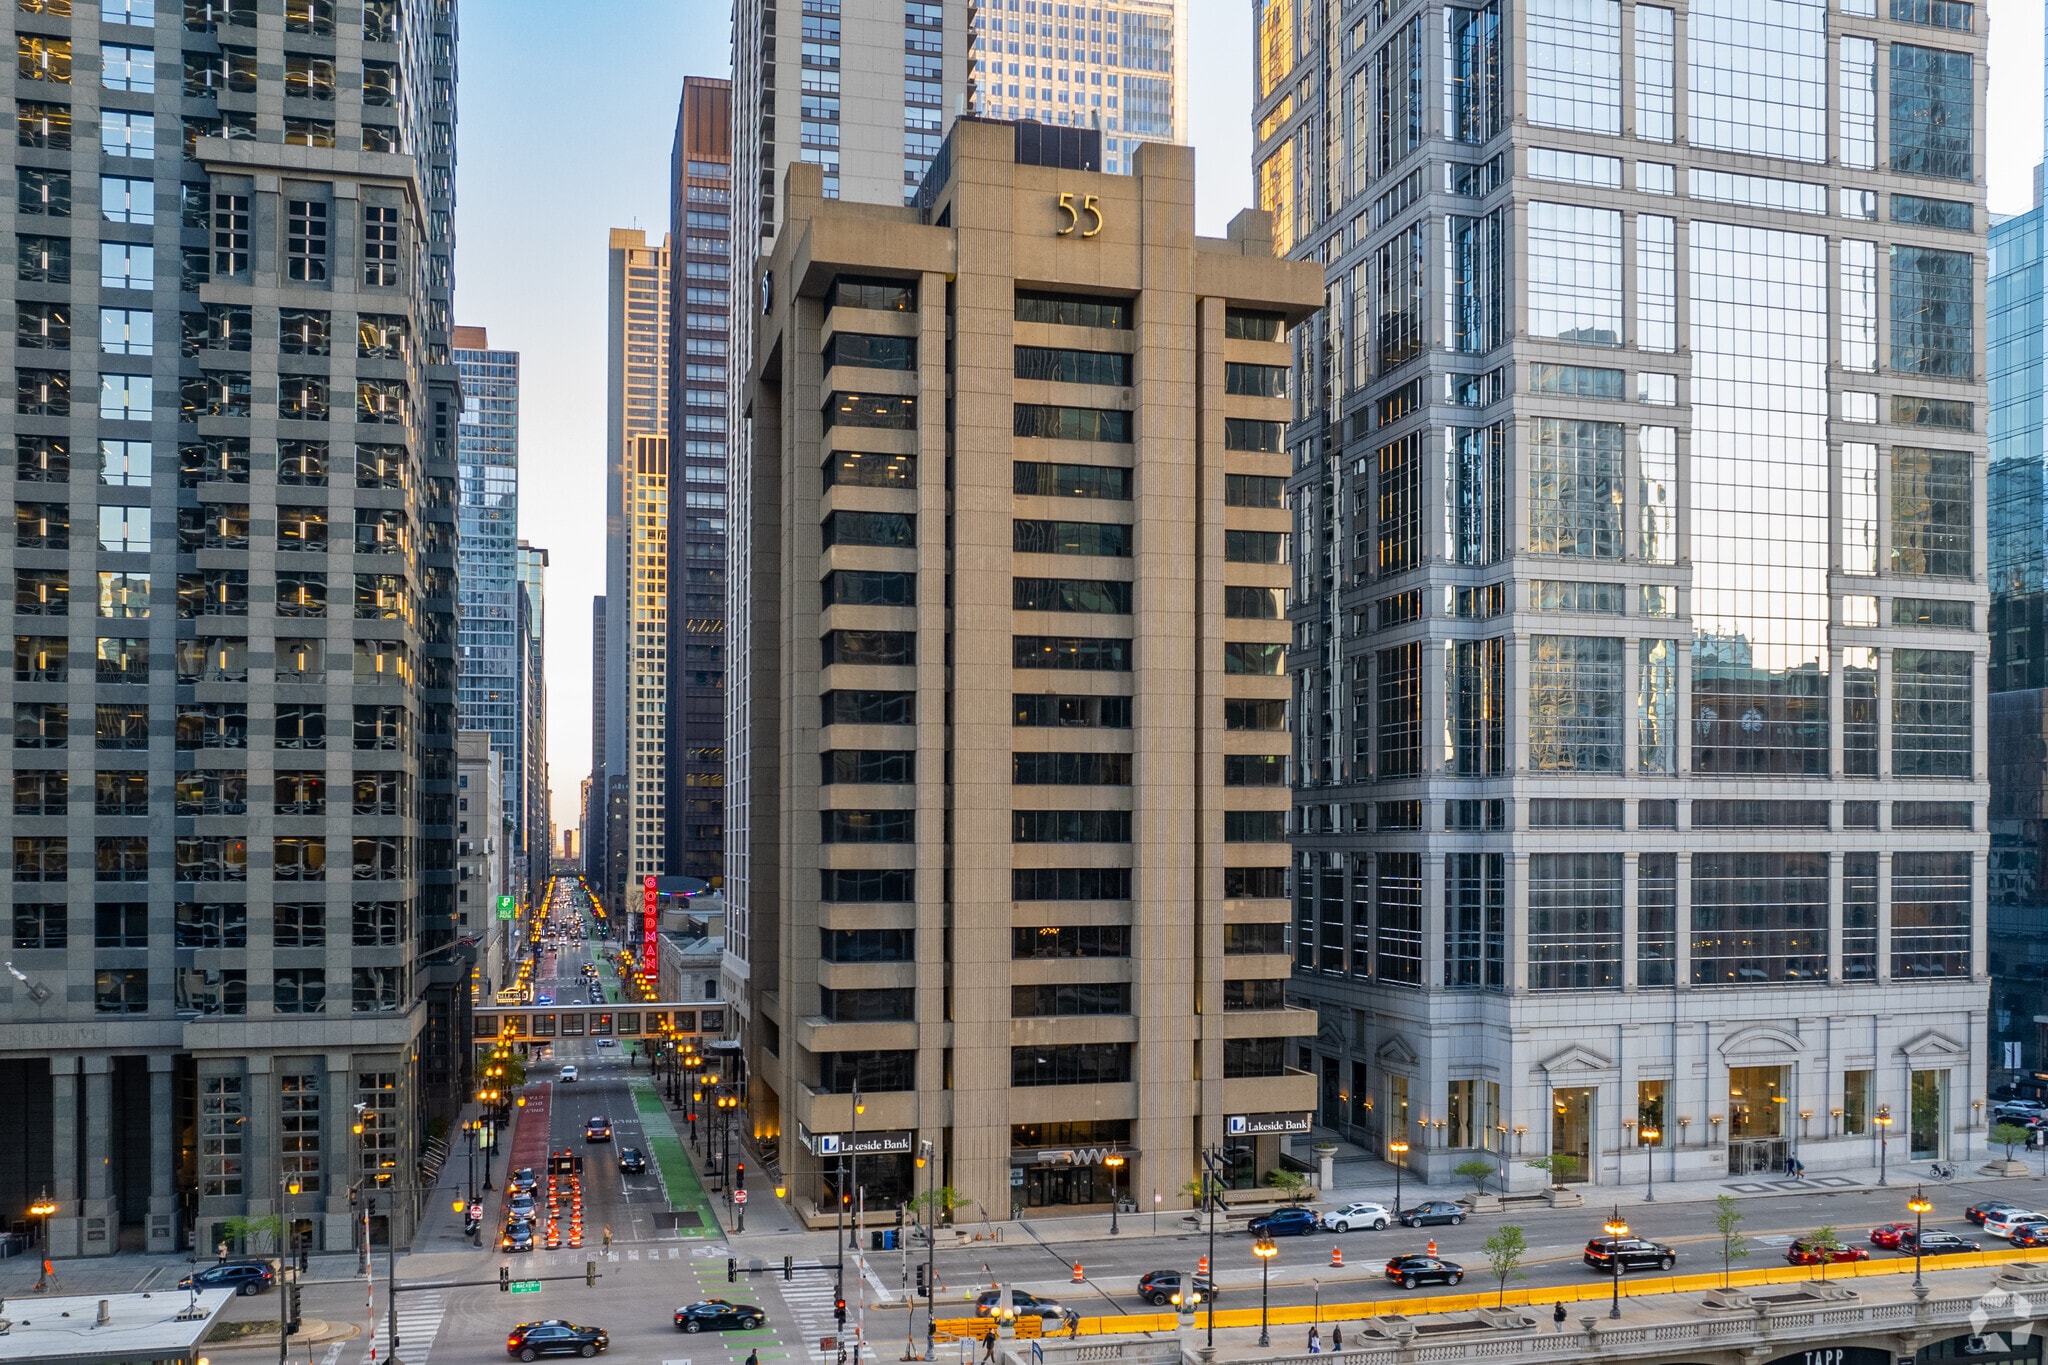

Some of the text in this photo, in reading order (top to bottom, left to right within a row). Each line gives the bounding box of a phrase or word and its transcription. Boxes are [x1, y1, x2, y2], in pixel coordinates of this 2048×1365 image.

[1057, 192, 1103, 236] 55
[645, 877, 656, 969] GOODMAN
[1248, 1121, 1284, 1131] Lakeside
[1285, 1119, 1307, 1130] Bank
[883, 1138, 908, 1149] Bank
[1805, 1349, 1843, 1365] TAPP
